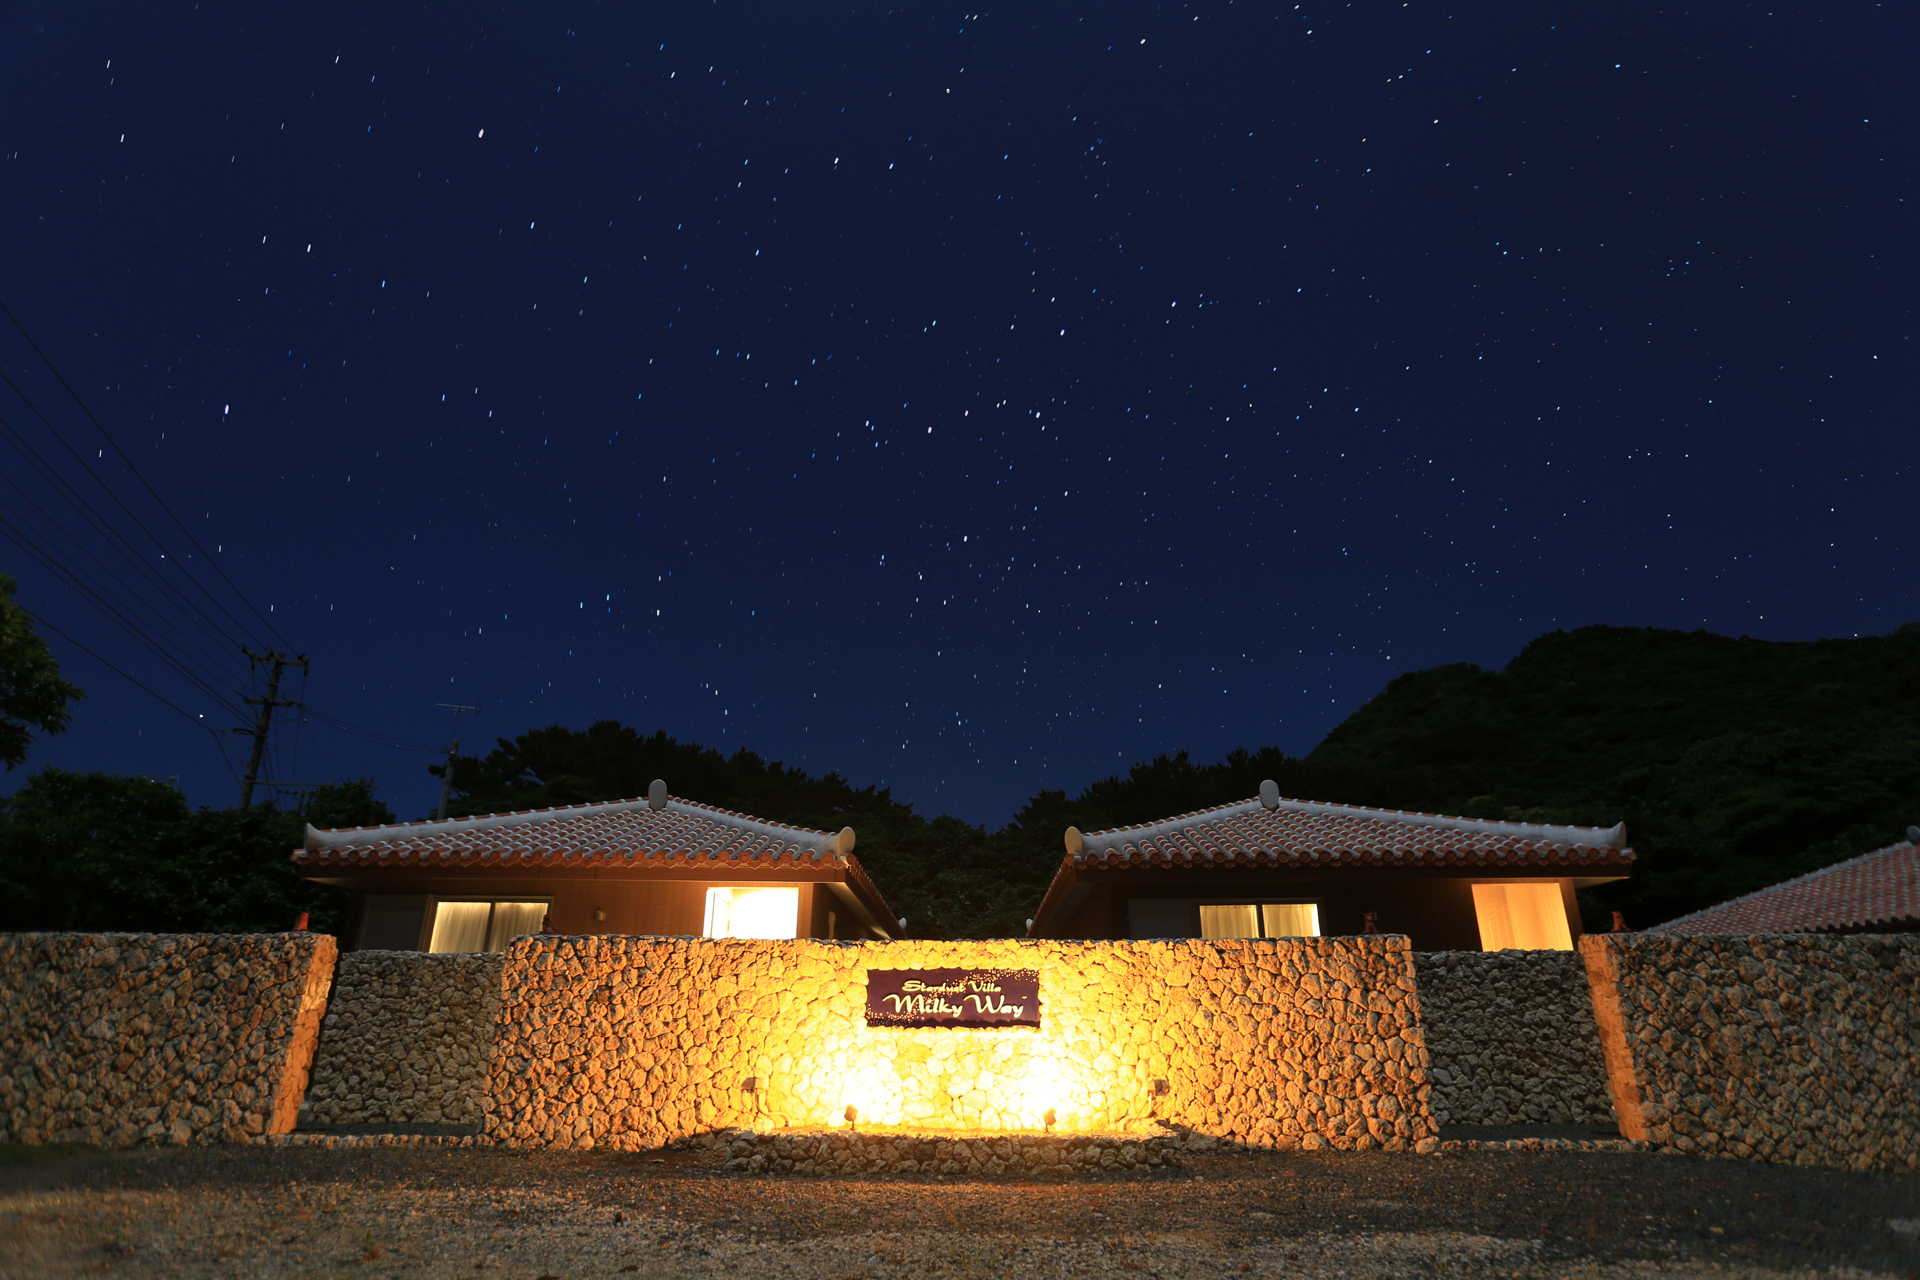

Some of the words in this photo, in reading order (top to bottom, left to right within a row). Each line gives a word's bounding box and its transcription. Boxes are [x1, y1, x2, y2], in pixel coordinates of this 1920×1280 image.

[902, 980, 965, 992] Stardust
[968, 980, 1001, 992] Villa
[882, 994, 963, 1018] Milky
[963, 994, 1024, 1018] Way
